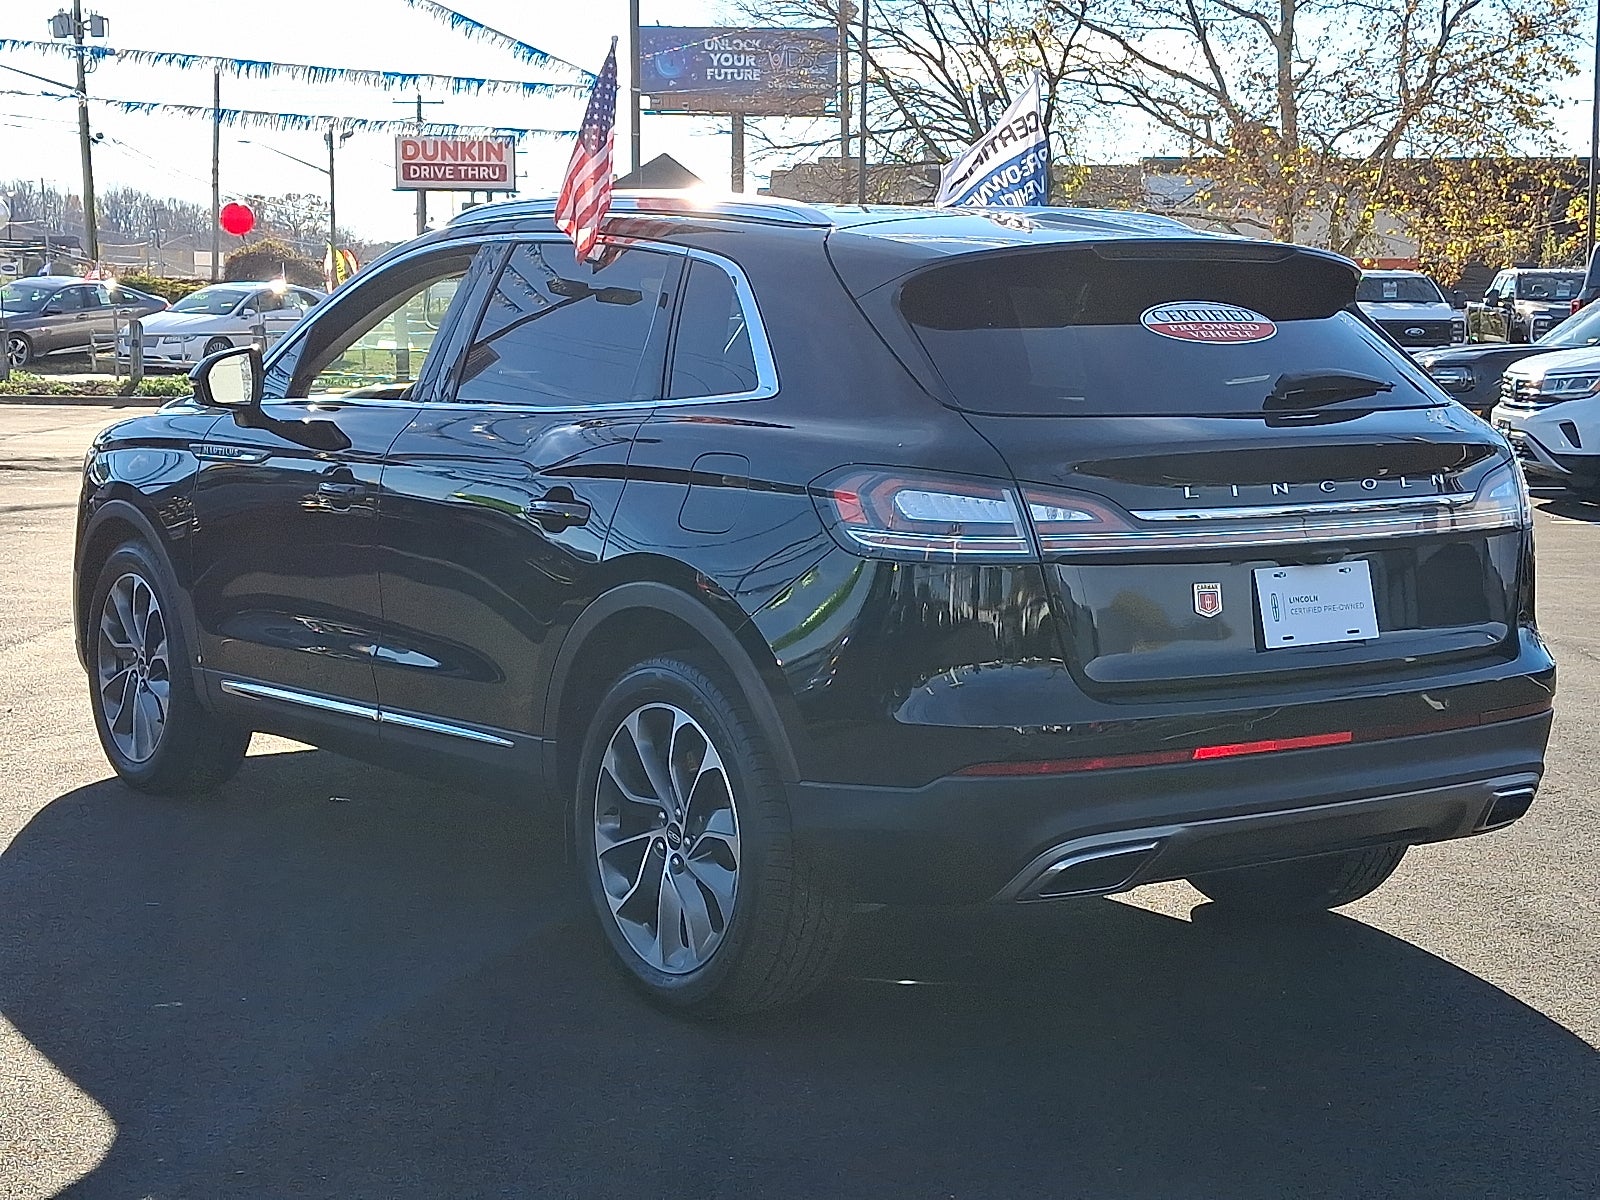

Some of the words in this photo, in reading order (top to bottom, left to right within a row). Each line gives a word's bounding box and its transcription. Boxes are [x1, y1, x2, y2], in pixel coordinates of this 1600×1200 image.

[704, 38, 762, 51] UNLOCK
[709, 53, 757, 67] YOUR
[706, 68, 761, 81] FUTURE
[409, 165, 454, 179] DRIVE
[457, 166, 500, 179] THRU
[1151, 309, 1255, 323] CERTIFIED
[1168, 323, 1260, 332] PRE-OWNED
[1189, 330, 1256, 338] VEHICLE
[1183, 473, 1446, 499] LINCOLN
[1289, 595, 1319, 604] LINCOLN
[1290, 606, 1322, 616] CERTIFIED
[1323, 602, 1365, 613] PRE-OWNED
